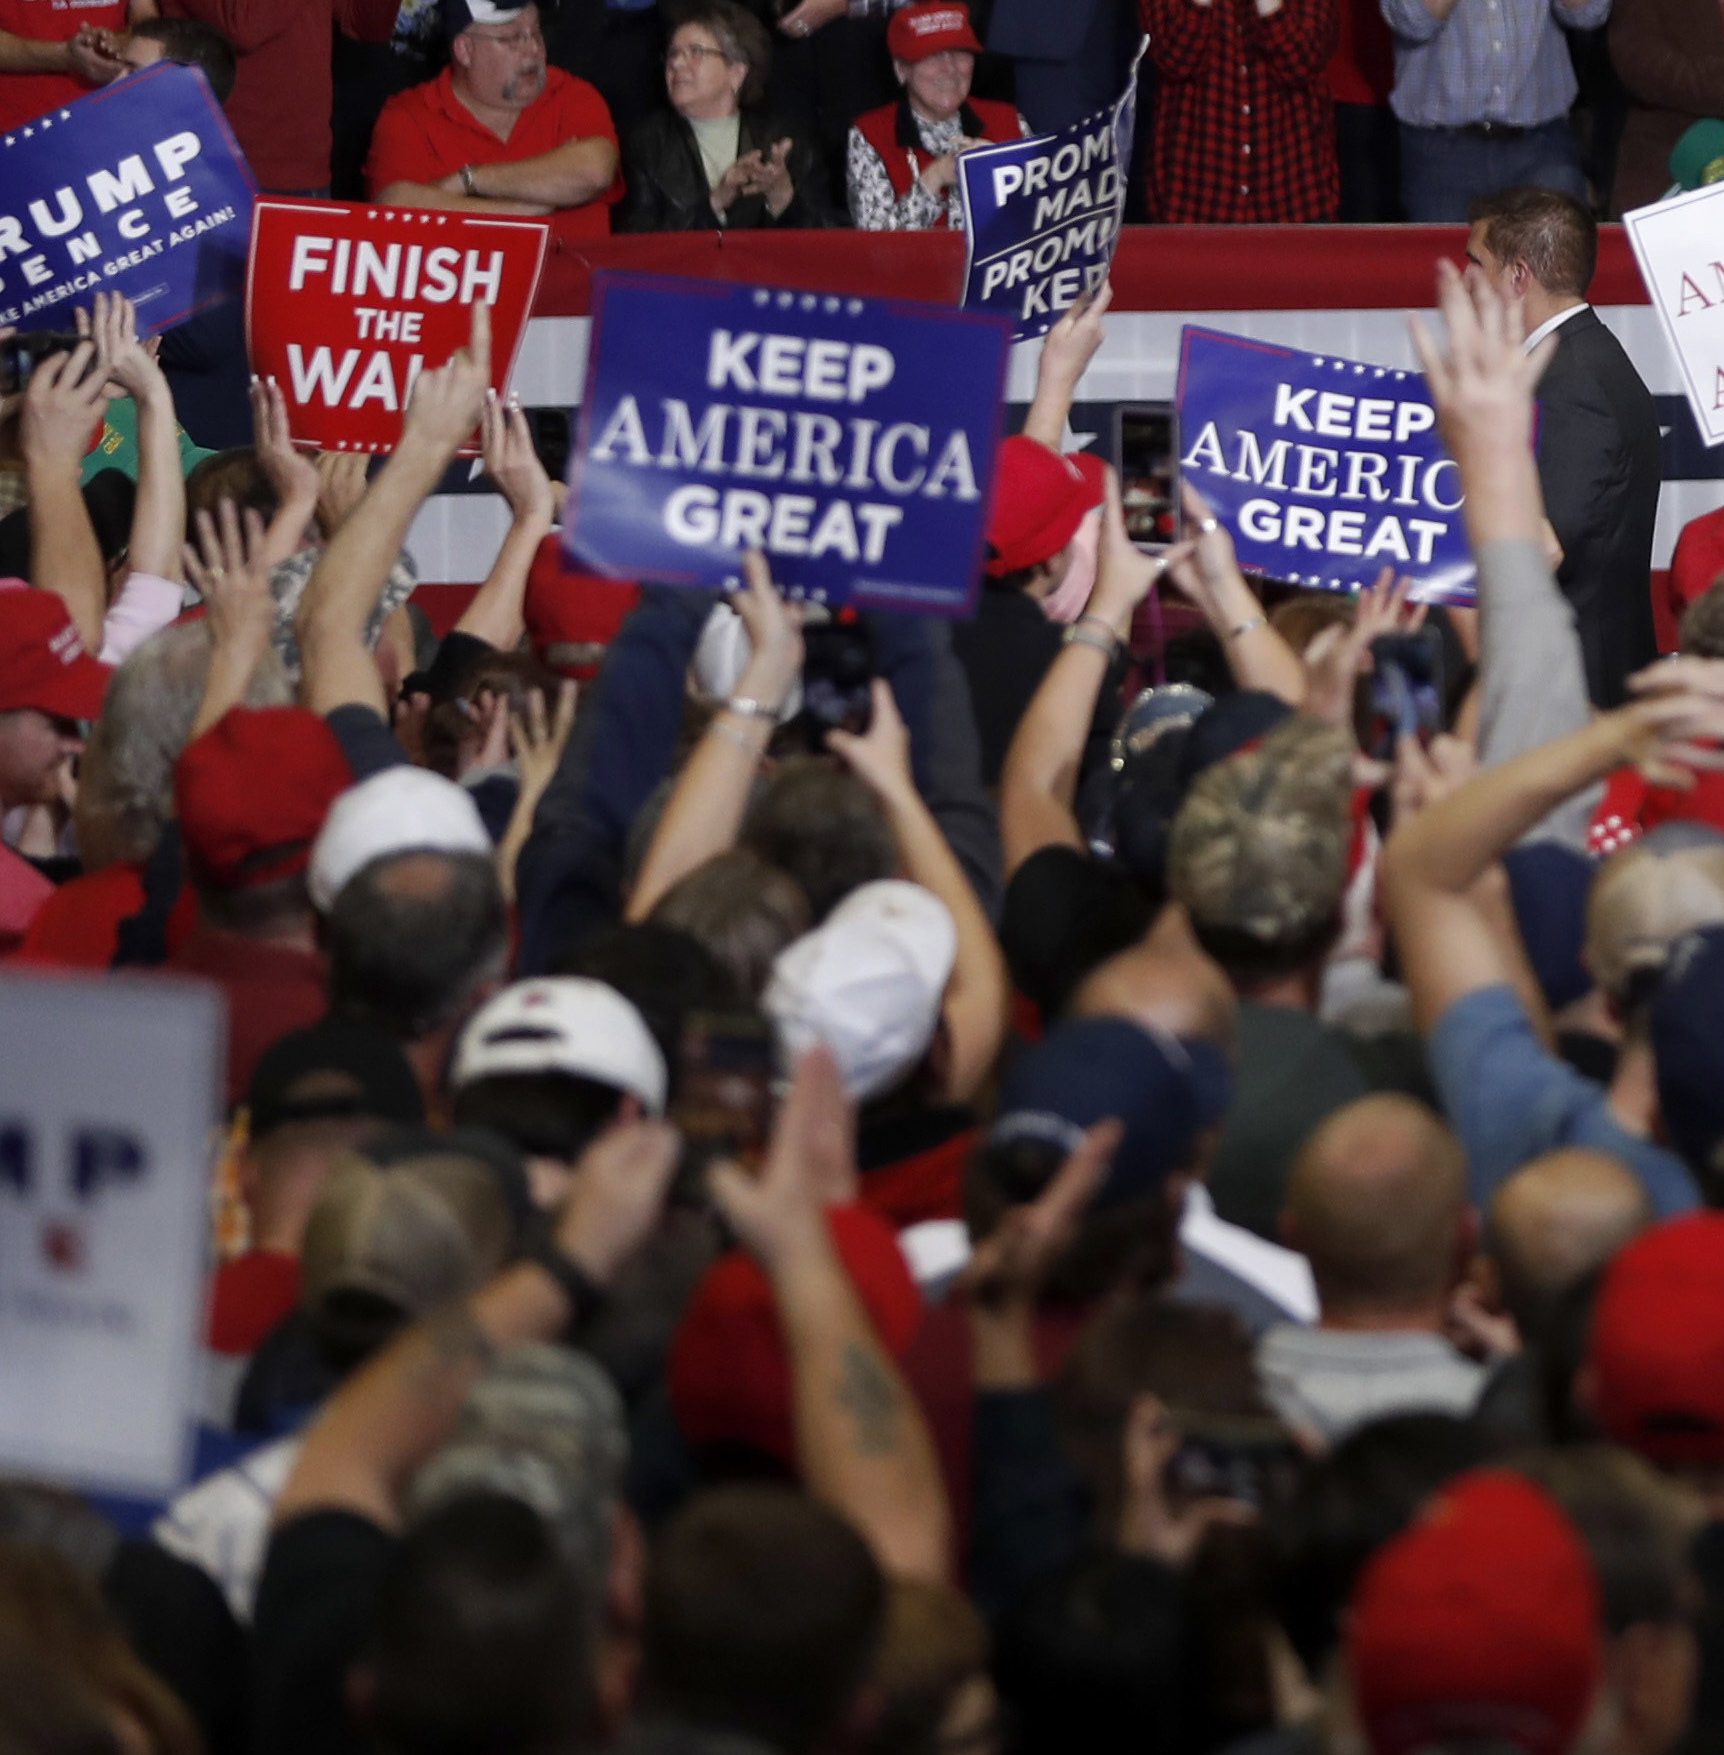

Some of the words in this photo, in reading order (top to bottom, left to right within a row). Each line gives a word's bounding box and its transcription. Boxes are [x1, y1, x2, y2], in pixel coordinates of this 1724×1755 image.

[993, 125, 1113, 208] PROM
[1033, 165, 1119, 231] MAD
[23, 270, 102, 317] AMERICA
[103, 238, 164, 276] GREAT
[169, 205, 236, 248] AGAIN!
[290, 236, 505, 306] FINISH
[981, 216, 1112, 301] PROMI
[1022, 261, 1108, 320] KEP
[354, 306, 424, 345] THE
[707, 329, 896, 405] KEEP
[593, 396, 982, 503] AMERICA
[1273, 382, 1434, 445] KEEP
[1183, 423, 1467, 512] AMERIC
[663, 484, 904, 565] GREAT
[1238, 498, 1447, 565] GREAT
